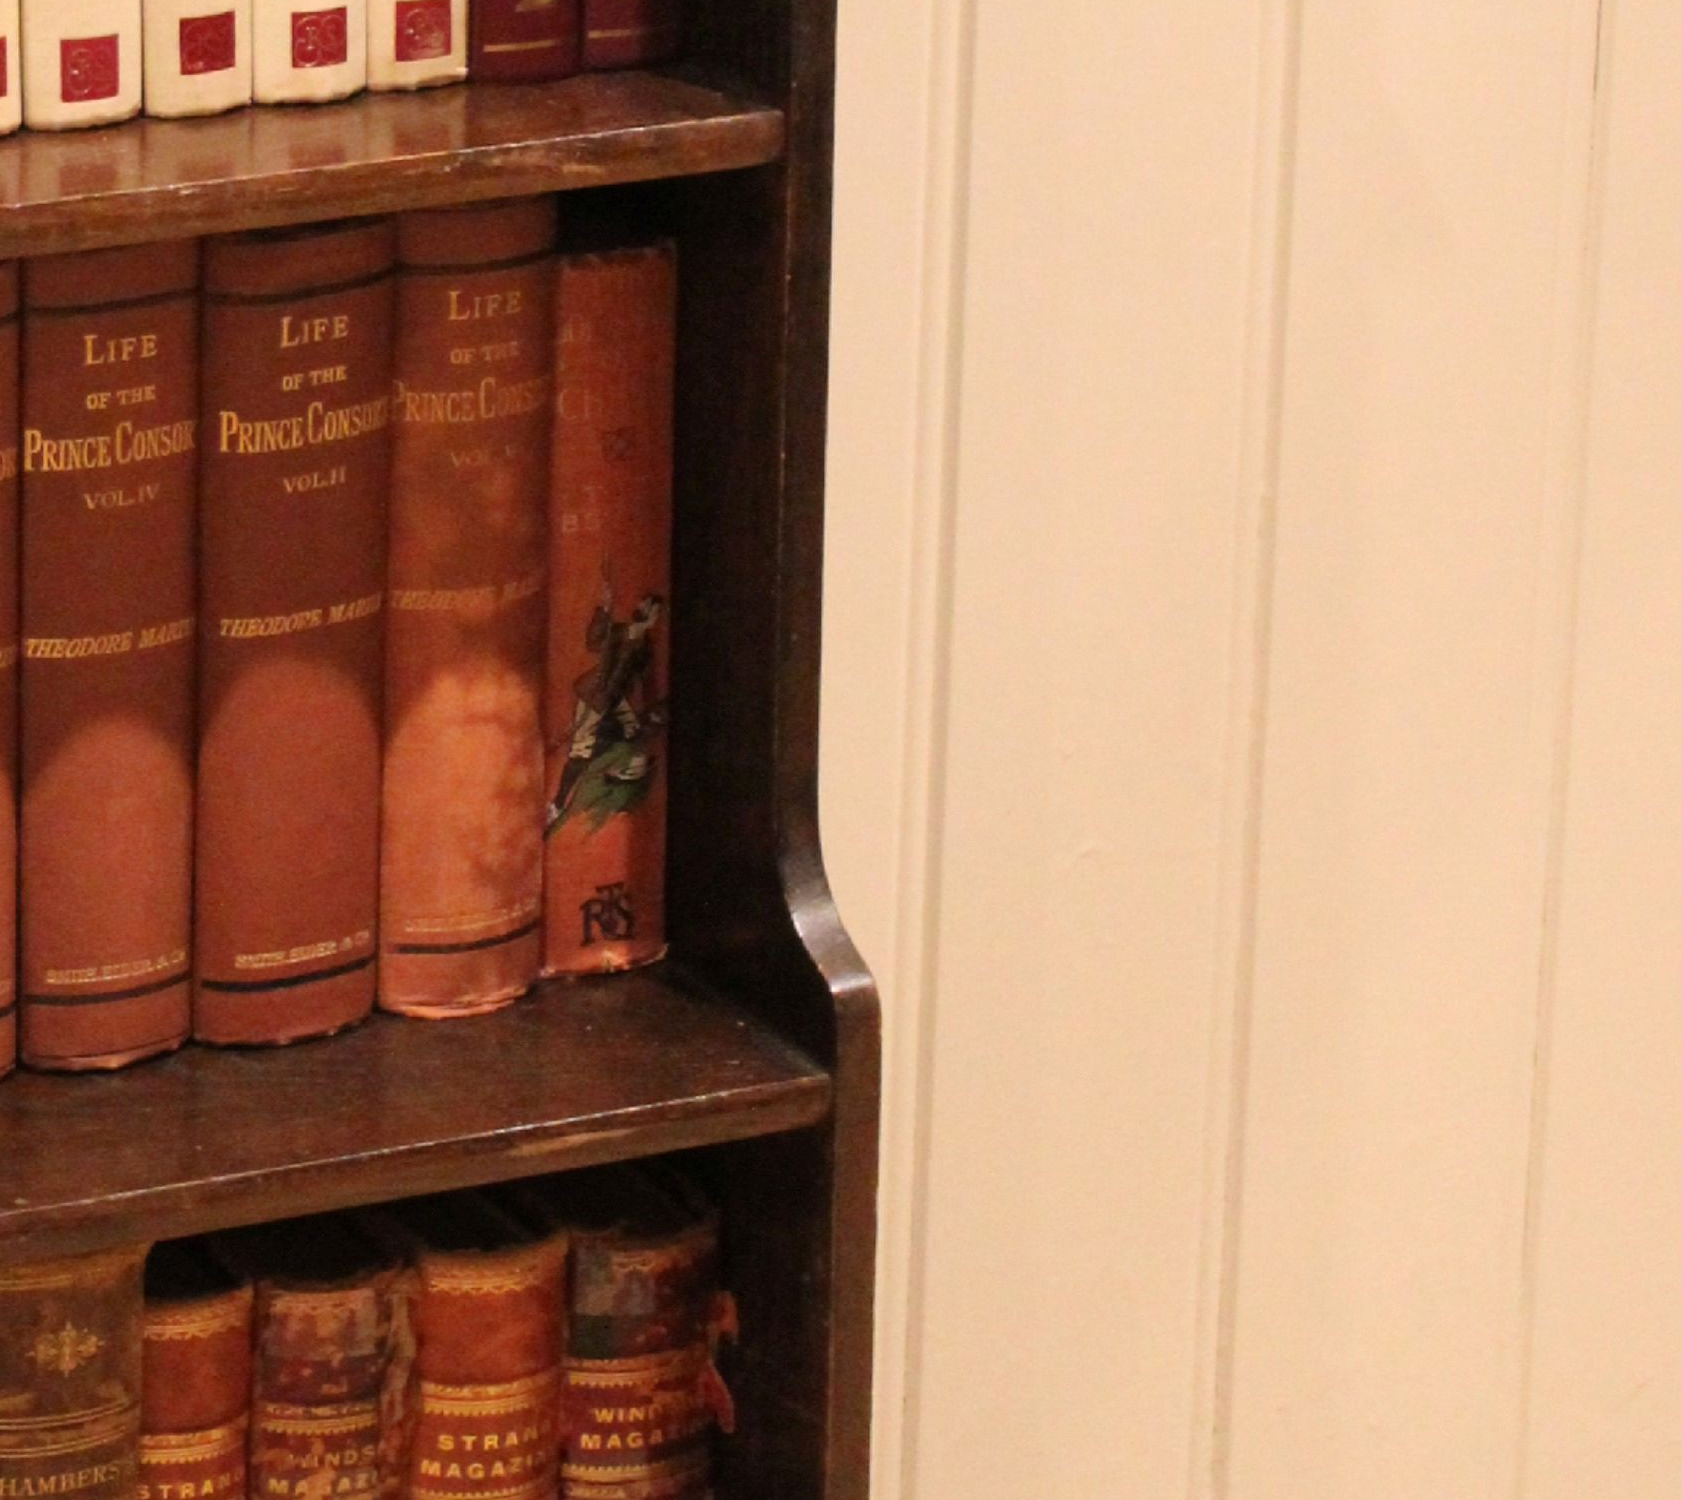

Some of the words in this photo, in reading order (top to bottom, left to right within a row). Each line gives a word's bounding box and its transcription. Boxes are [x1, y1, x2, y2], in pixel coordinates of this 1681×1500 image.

[446, 289, 522, 321] LIFE
[280, 315, 349, 349] LIFE
[83, 334, 158, 366] LIFE
[449, 347, 476, 365] OF
[479, 340, 519, 362] THE
[281, 373, 304, 392] OF
[308, 365, 348, 387] THE
[85, 391, 111, 410] OF
[116, 384, 157, 406] THE
[23, 428, 112, 473] PRINCE
[115, 420, 199, 465] CONSOR
[219, 410, 304, 454] PRINCE
[220, 608, 323, 639] THEODORE
[24, 630, 134, 659] THEODORE
[580, 1429, 664, 1451] MAGA
[420, 1450, 546, 1480] MAGAZI
